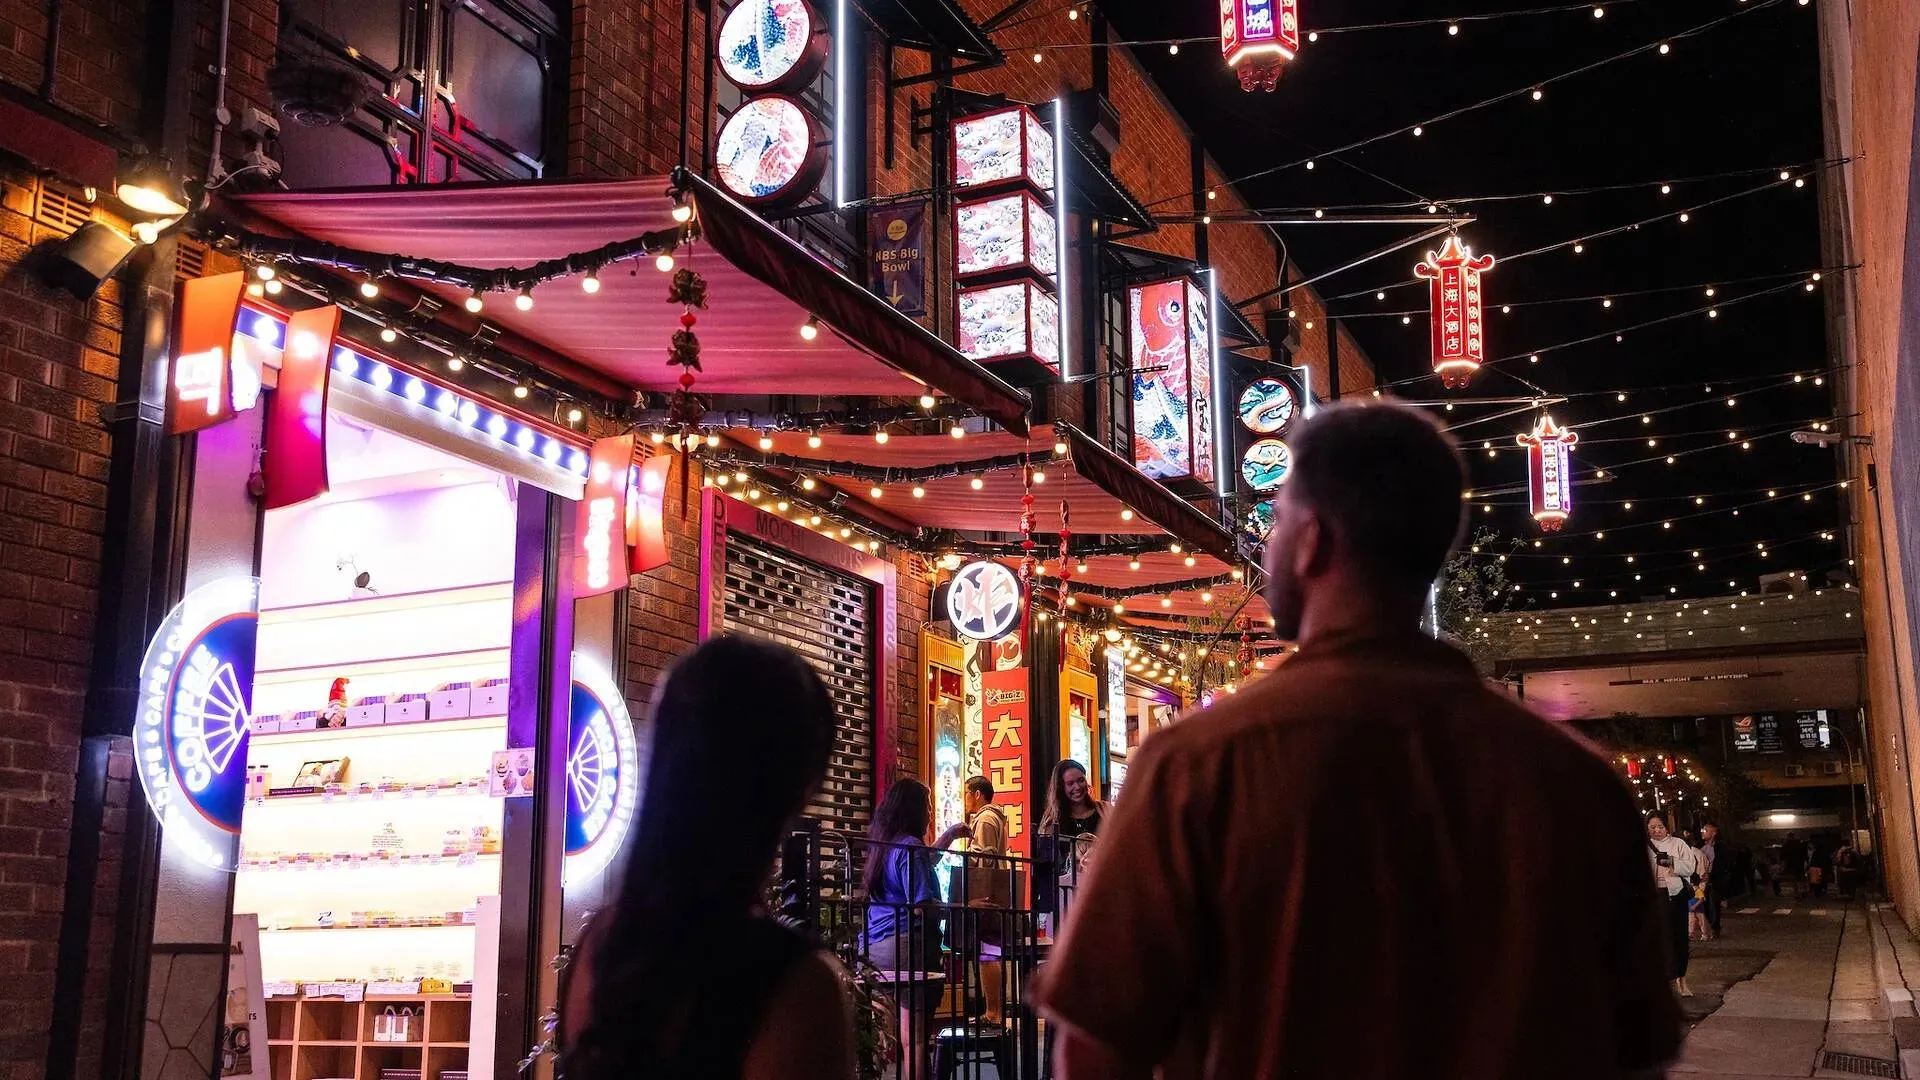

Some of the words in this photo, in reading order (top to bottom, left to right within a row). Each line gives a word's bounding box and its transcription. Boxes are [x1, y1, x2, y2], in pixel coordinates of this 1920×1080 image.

[875, 250, 897, 262] NBS
[900, 247, 918, 259] Big
[882, 260, 910, 272] Bowl
[1444, 273, 1460, 350] 上海大酒店
[174, 643, 219, 792] COFFEE
